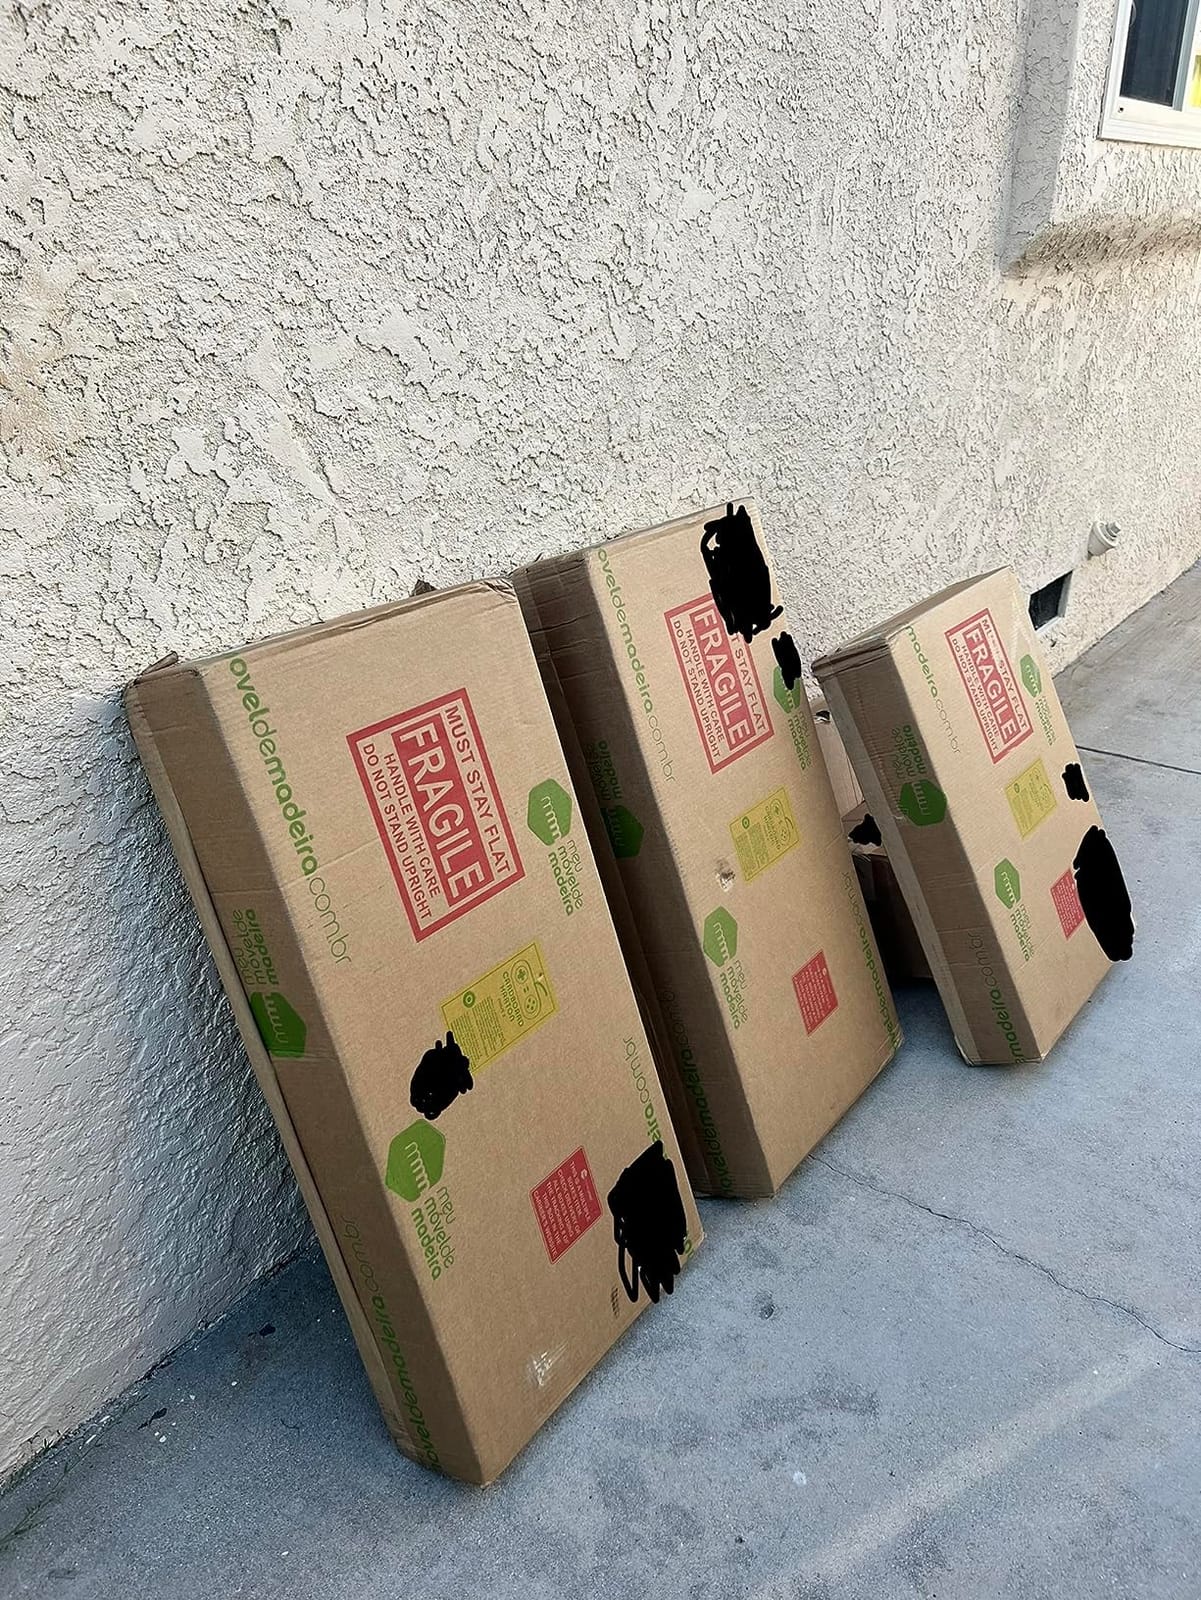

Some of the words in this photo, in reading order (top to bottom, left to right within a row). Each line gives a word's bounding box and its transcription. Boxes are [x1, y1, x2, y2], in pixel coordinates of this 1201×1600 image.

[673, 620, 684, 638] DO
[680, 640, 692, 664] NOT
[687, 667, 704, 705] STAND
[701, 707, 721, 758] UPRIGHT
[685, 629, 705, 677] HANDLE
[700, 679, 714, 709] WITH
[710, 710, 725, 743] CARE
[694, 609, 750, 744] FRAGILE
[734, 648, 753, 687] STAY
[748, 692, 766, 731] FLAT
[952, 638, 961, 654] DO
[958, 655, 970, 675] NOT
[966, 676, 982, 708] STAND
[979, 708, 999, 751] UPRIGHT
[961, 644, 979, 684] HANDLE
[977, 686, 991, 708] WITH
[986, 709, 999, 738] CARE
[965, 626, 1017, 740] FRAGILE
[999, 660, 1014, 691] STAY
[1012, 693, 1027, 729] FLAT
[903, 725, 927, 774] madeira
[383, 753, 413, 815] HANDLE
[405, 815, 426, 856] WITH
[419, 856, 441, 898] CARE
[400, 722, 485, 898] FRAGILE
[444, 705, 475, 765] MUST
[466, 769, 493, 820] STAY
[484, 825, 511, 873] FLAT
[363, 743, 379, 767] DO
[372, 770, 391, 802] NOT
[384, 805, 408, 855] STAND
[402, 856, 433, 919] UPRIGHT
[567, 839, 583, 872] meu
[549, 852, 574, 916] madeira
[234, 948, 256, 985] meu
[245, 909, 279, 985] madeira
[735, 960, 748, 990] meu
[1010, 914, 1030, 961] madeira
[720, 972, 740, 1029] madeira
[411, 1207, 442, 1280] madeira
[424, 1197, 456, 1269] móvelde
[436, 1187, 456, 1224] meu
